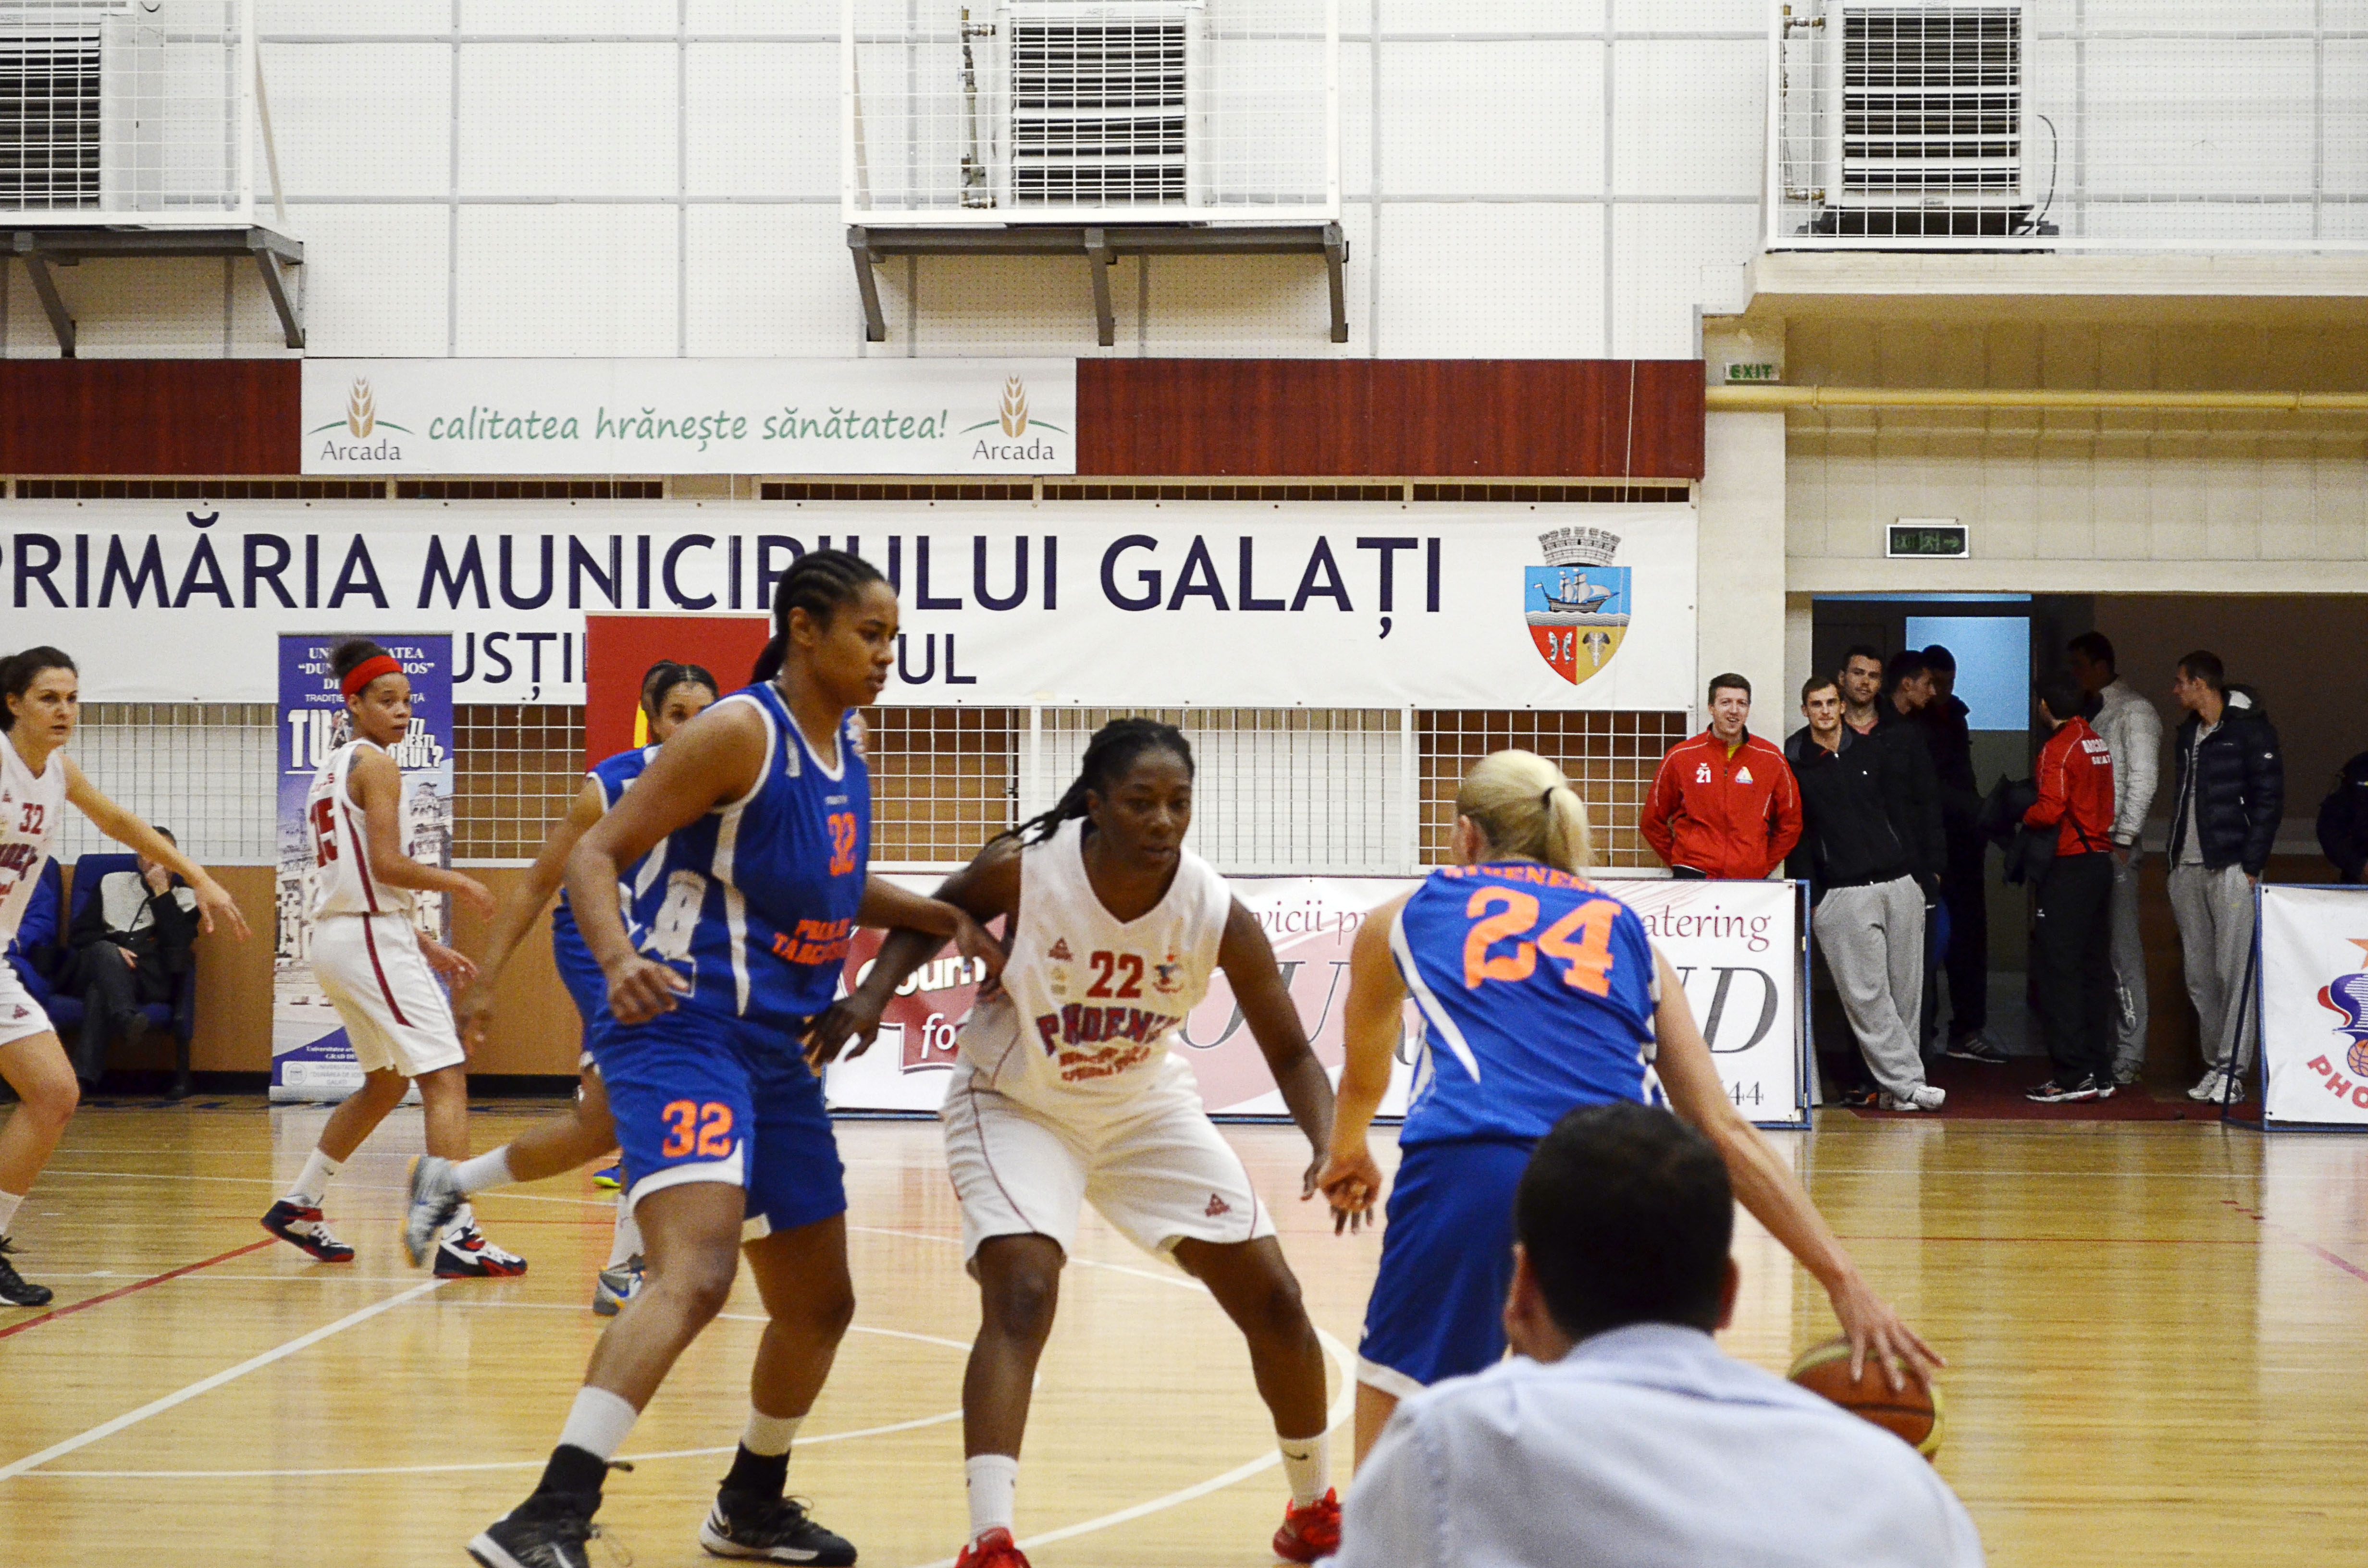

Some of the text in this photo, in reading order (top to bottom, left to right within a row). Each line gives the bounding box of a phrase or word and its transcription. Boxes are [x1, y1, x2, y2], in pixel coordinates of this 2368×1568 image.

[1731, 364, 1772, 379] EXIT
[429, 406, 579, 440] calitatea
[762, 406, 949, 439] sănătatea!
[321, 440, 401, 461] Arcada
[973, 440, 1055, 460] Arcada
[0, 511, 390, 609] RIMĂRIA
[1100, 533, 1441, 639] GALAȚI
[1696, 769, 1711, 783] 21
[19, 803, 44, 835] 32
[827, 812, 857, 877] 32
[1464, 886, 1622, 999] 24
[1642, 905, 1772, 952] atering
[1085, 950, 1143, 998] 22
[661, 1098, 734, 1158] 32
